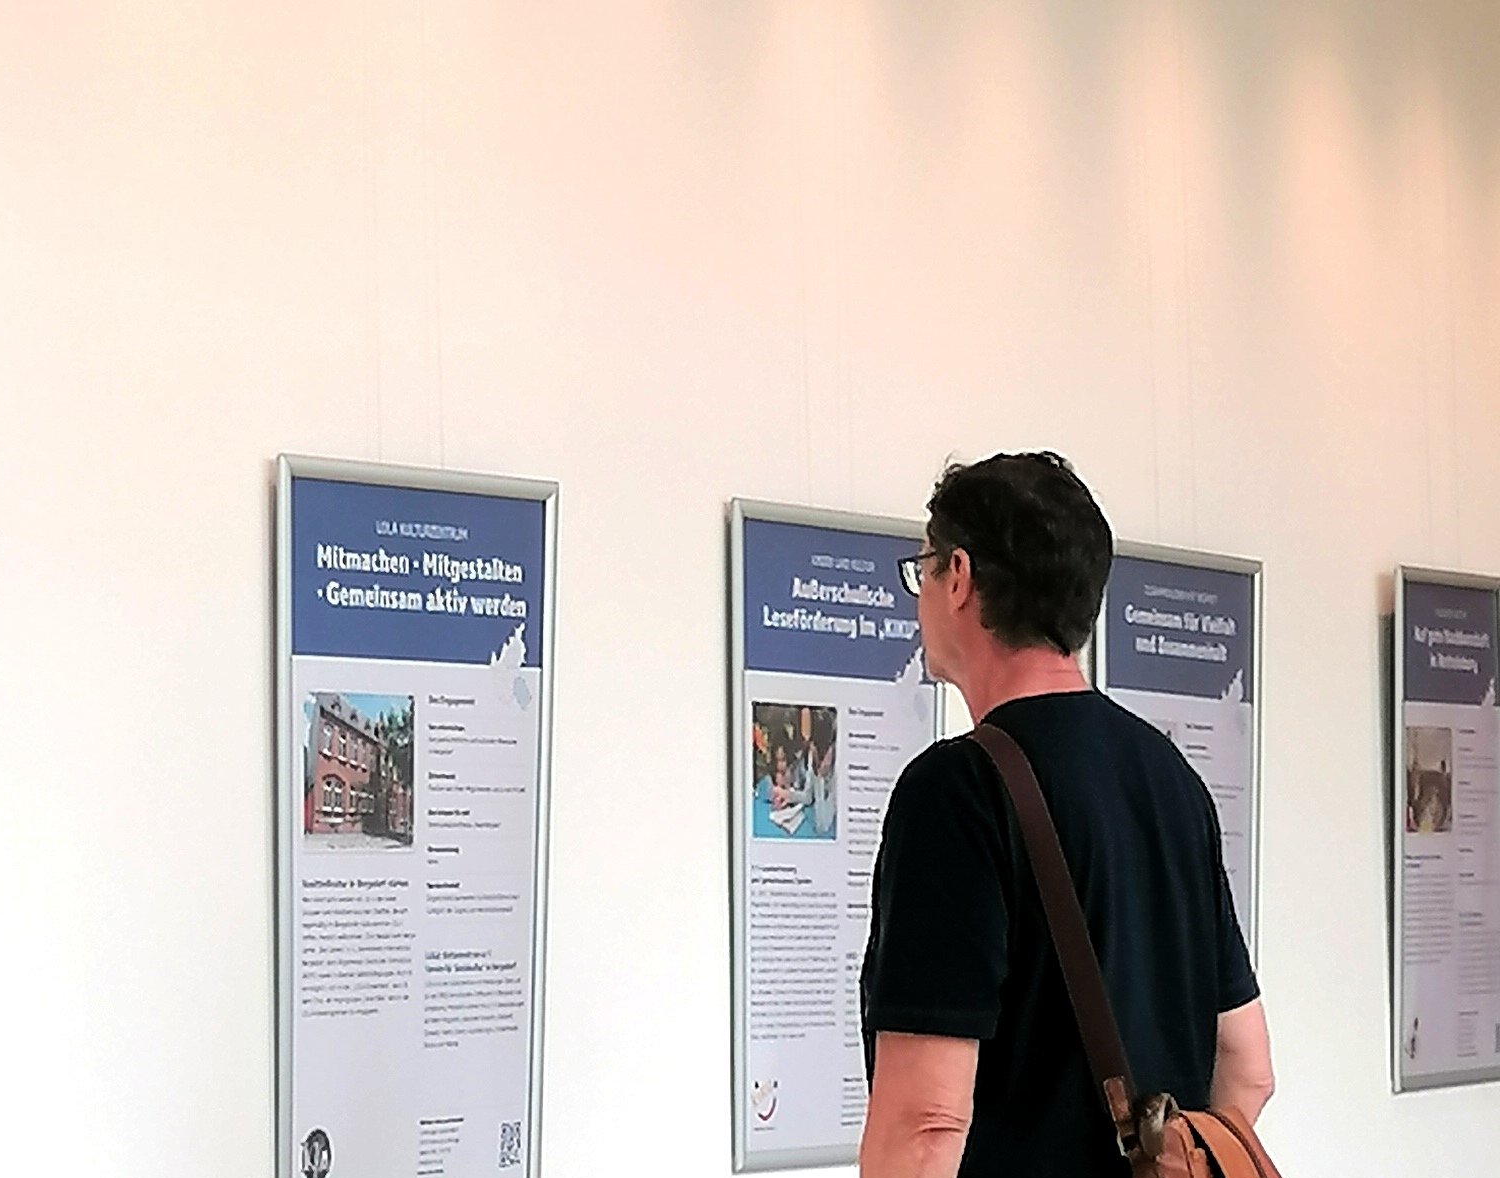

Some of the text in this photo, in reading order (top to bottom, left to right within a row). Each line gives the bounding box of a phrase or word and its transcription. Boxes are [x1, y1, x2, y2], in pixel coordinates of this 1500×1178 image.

[317, 543, 522, 584] Mitmachen Mitgestalten
[326, 581, 526, 618] Gemeinsam aktiv werden
[792, 576, 895, 608] Außerschulische
[763, 605, 857, 639] Leseförderung
[860, 613, 876, 636] im
